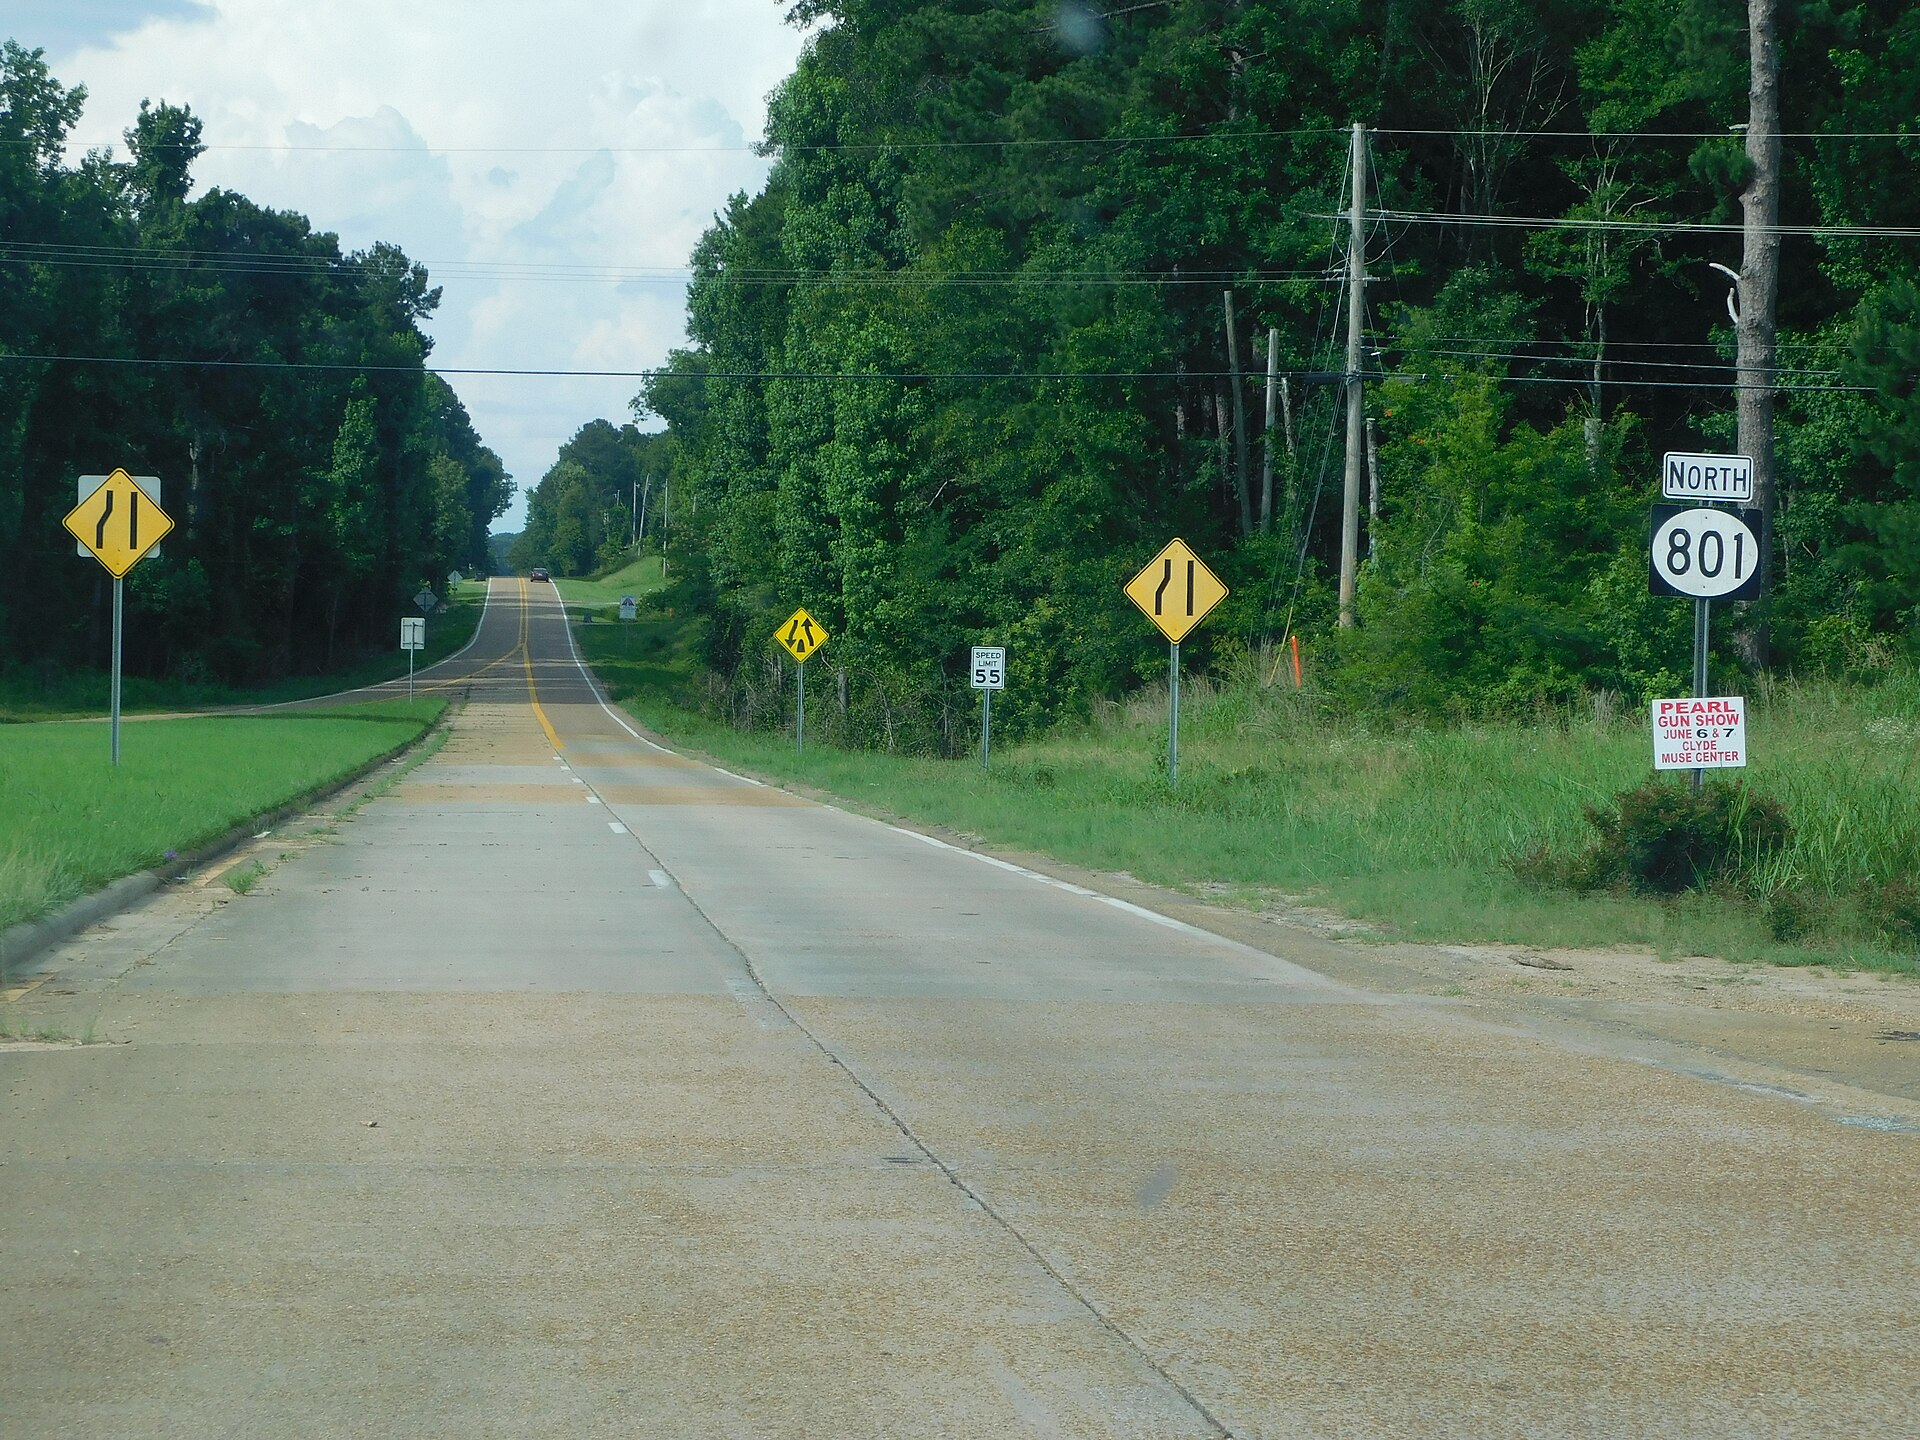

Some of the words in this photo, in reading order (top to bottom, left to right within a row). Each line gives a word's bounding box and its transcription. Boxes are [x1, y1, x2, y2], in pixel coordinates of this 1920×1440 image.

[1670, 461, 1747, 491] NORTH
[1667, 528, 1743, 579] 801
[975, 669, 1000, 683] 55
[1661, 701, 1736, 714] PEARL
[1658, 715, 1690, 727] GUN
[1696, 714, 1739, 726] SHOW
[1663, 729, 1692, 739] JUNE
[1696, 729, 1708, 738] 6
[1712, 728, 1719, 738] &
[1723, 728, 1735, 737] 7
[1682, 740, 1717, 751] CLYDE
[1662, 752, 1692, 763] MUSE
[1696, 751, 1739, 762] CENTER
